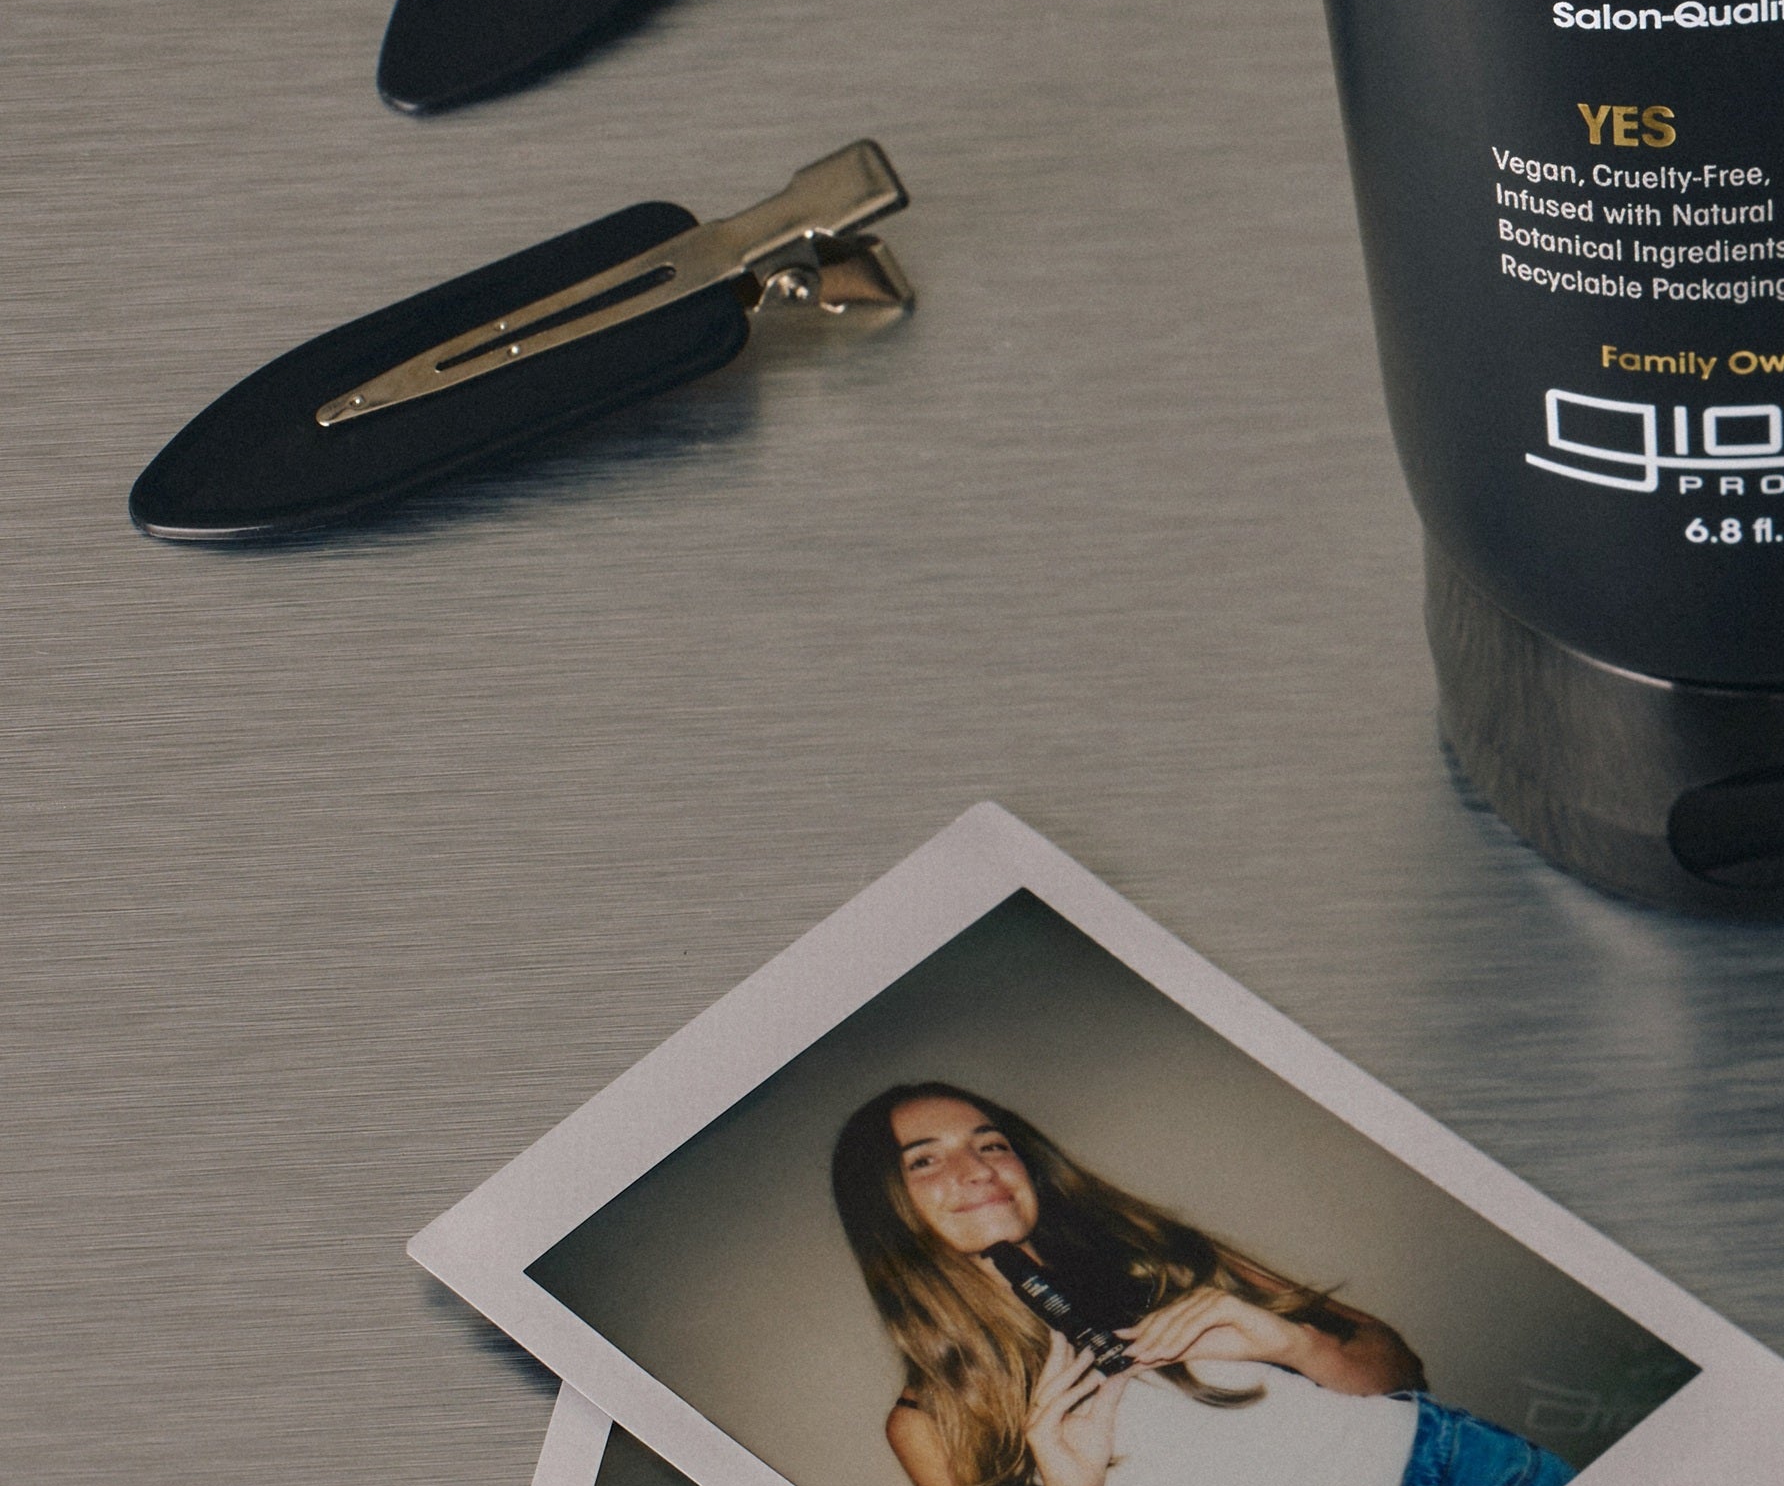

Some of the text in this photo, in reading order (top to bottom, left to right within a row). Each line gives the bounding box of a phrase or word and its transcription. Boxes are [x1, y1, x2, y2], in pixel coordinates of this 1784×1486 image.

[1576, 102, 1677, 148] YES
[1491, 146, 1771, 194] Vegan, Cruelty-Free,
[1495, 179, 1774, 227] Infused with Natural
[1498, 217, 1623, 261] Botanical
[1500, 252, 1643, 299] Recyclable
[1601, 344, 1717, 380] Family
[1684, 517, 1743, 545] 6.8
[1752, 516, 1784, 544] fl.
